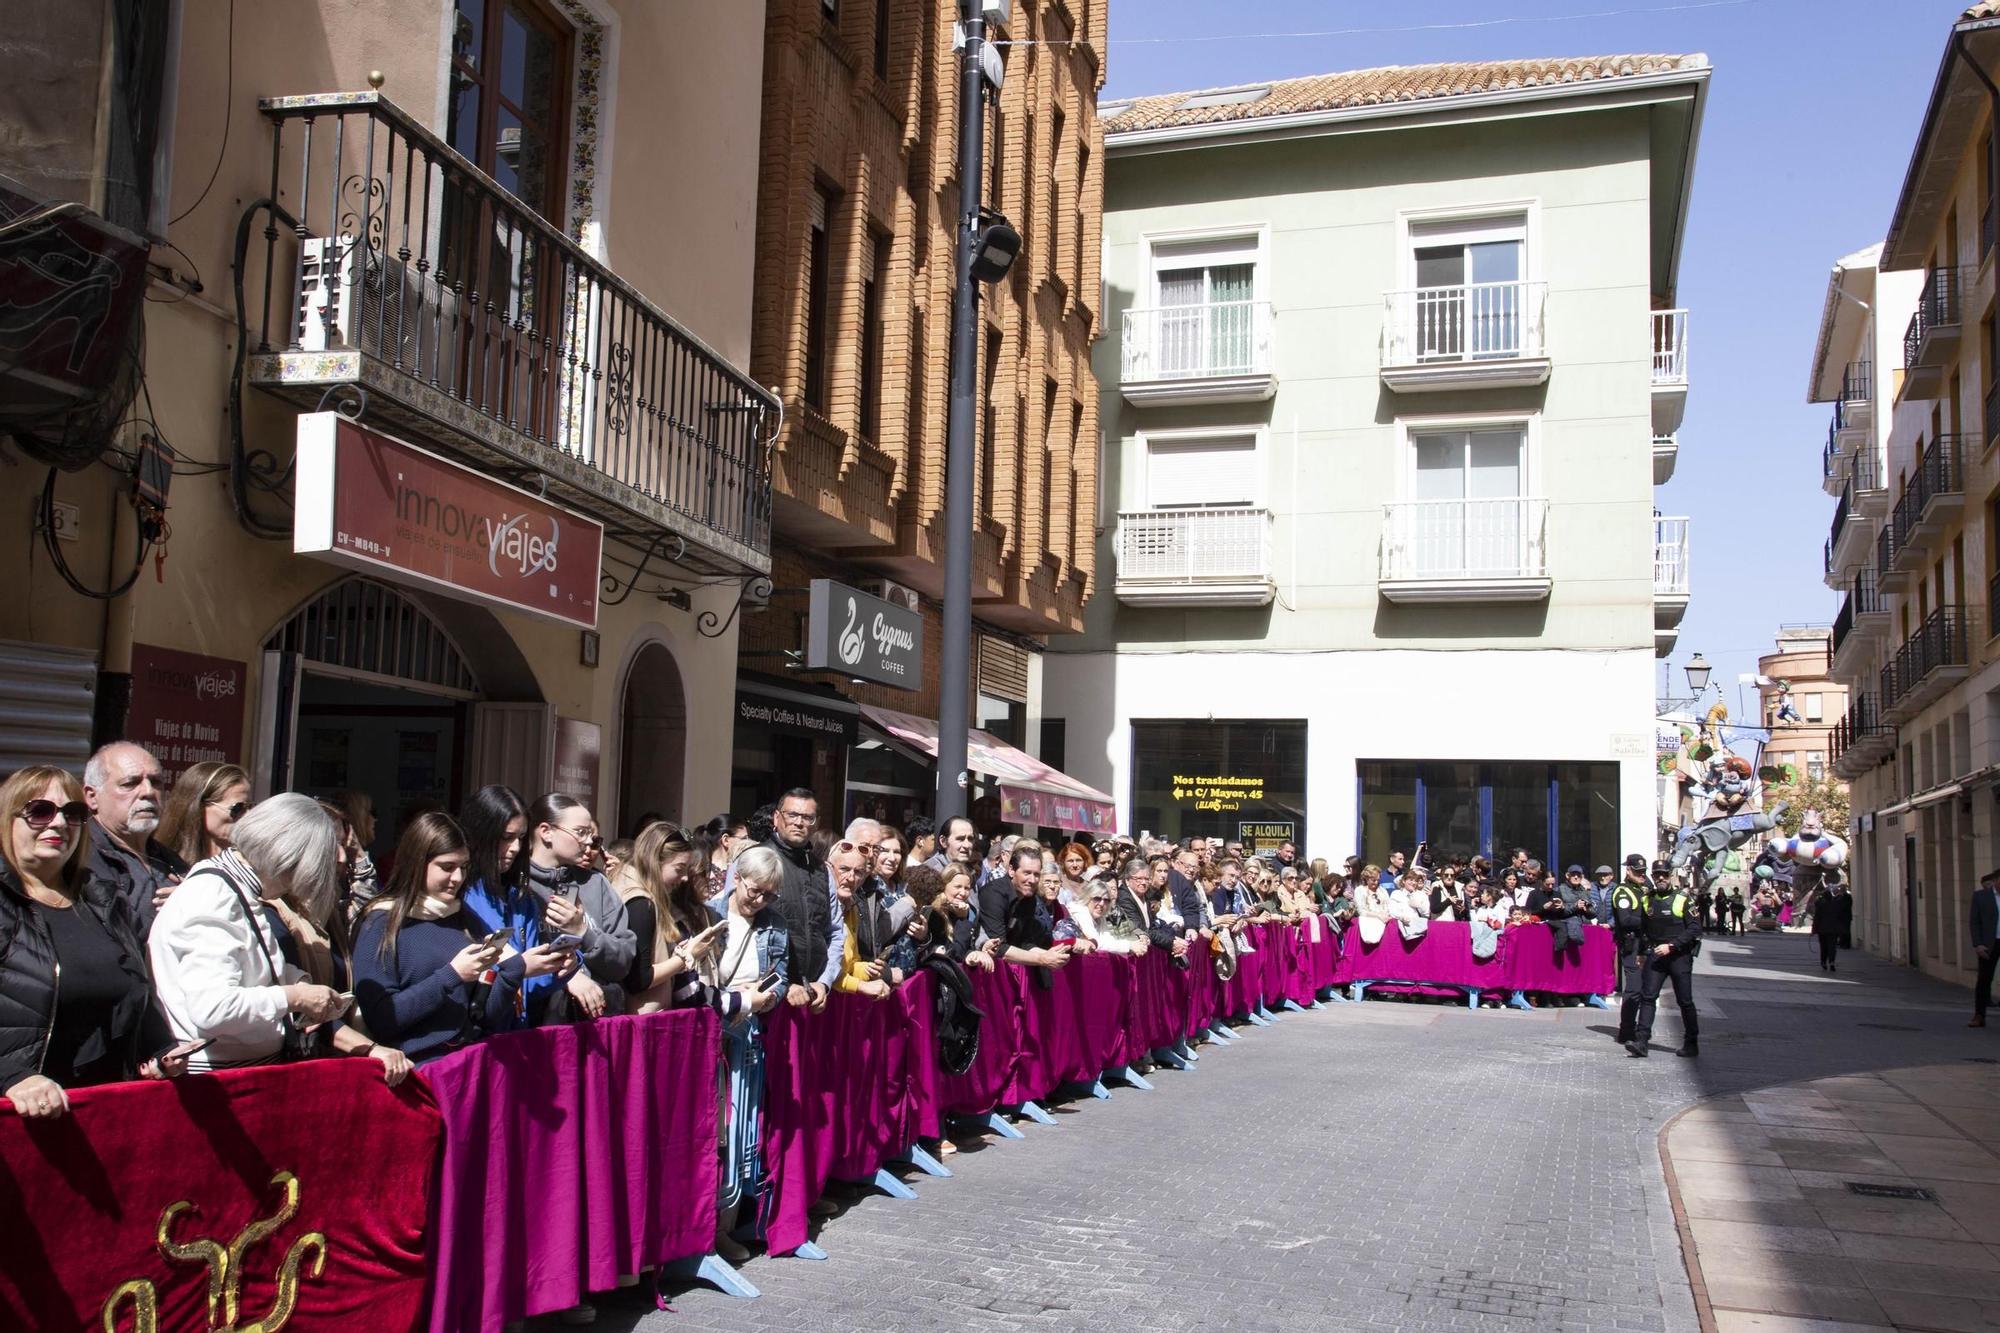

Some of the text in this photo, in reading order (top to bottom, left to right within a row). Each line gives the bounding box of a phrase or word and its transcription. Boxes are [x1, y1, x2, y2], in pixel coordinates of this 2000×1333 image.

[872, 612, 914, 656] Cygnus
[881, 659, 905, 675] COFFEE
[741, 702, 843, 733] Specialty Coffee & Natural Juices
[155, 718, 219, 741] Viajes de Novios
[1657, 735, 1680, 743] ENDE
[171, 743, 182, 760] de
[184, 745, 226, 763] Estudiantes
[1173, 775, 1264, 786] Nos trasladamos
[1195, 788, 1208, 799] C/
[1210, 788, 1247, 799] Mayor,
[1249, 790, 1263, 799] 45
[1241, 825, 1291, 837] SE ALQUILA
